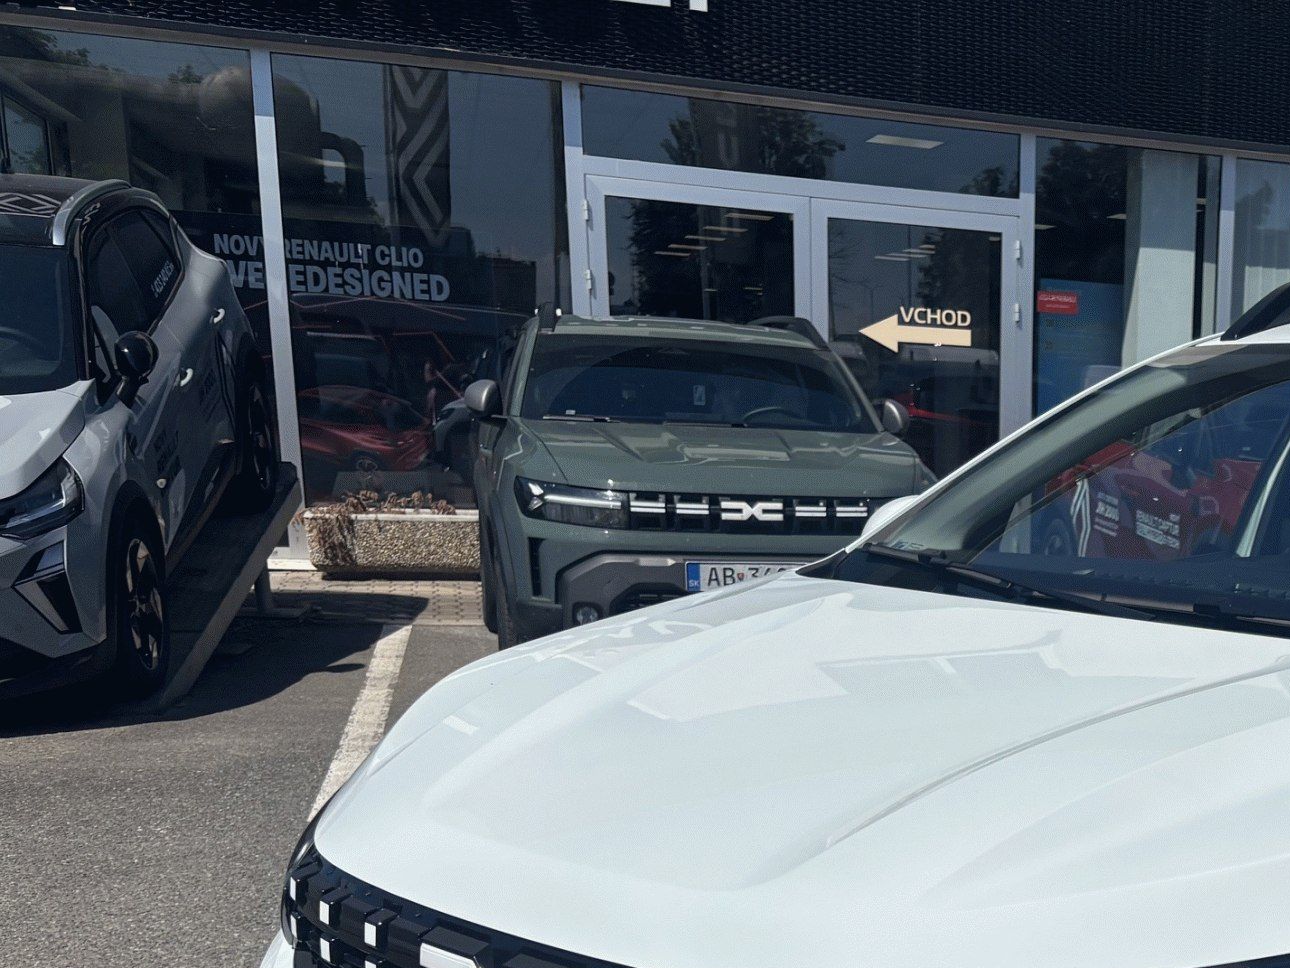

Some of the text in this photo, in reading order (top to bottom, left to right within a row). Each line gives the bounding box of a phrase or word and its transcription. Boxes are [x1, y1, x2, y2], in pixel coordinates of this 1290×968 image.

[375, 245, 424, 269] CLIO
[289, 263, 451, 302] EDESIGNED
[899, 306, 972, 327] VCHOD
